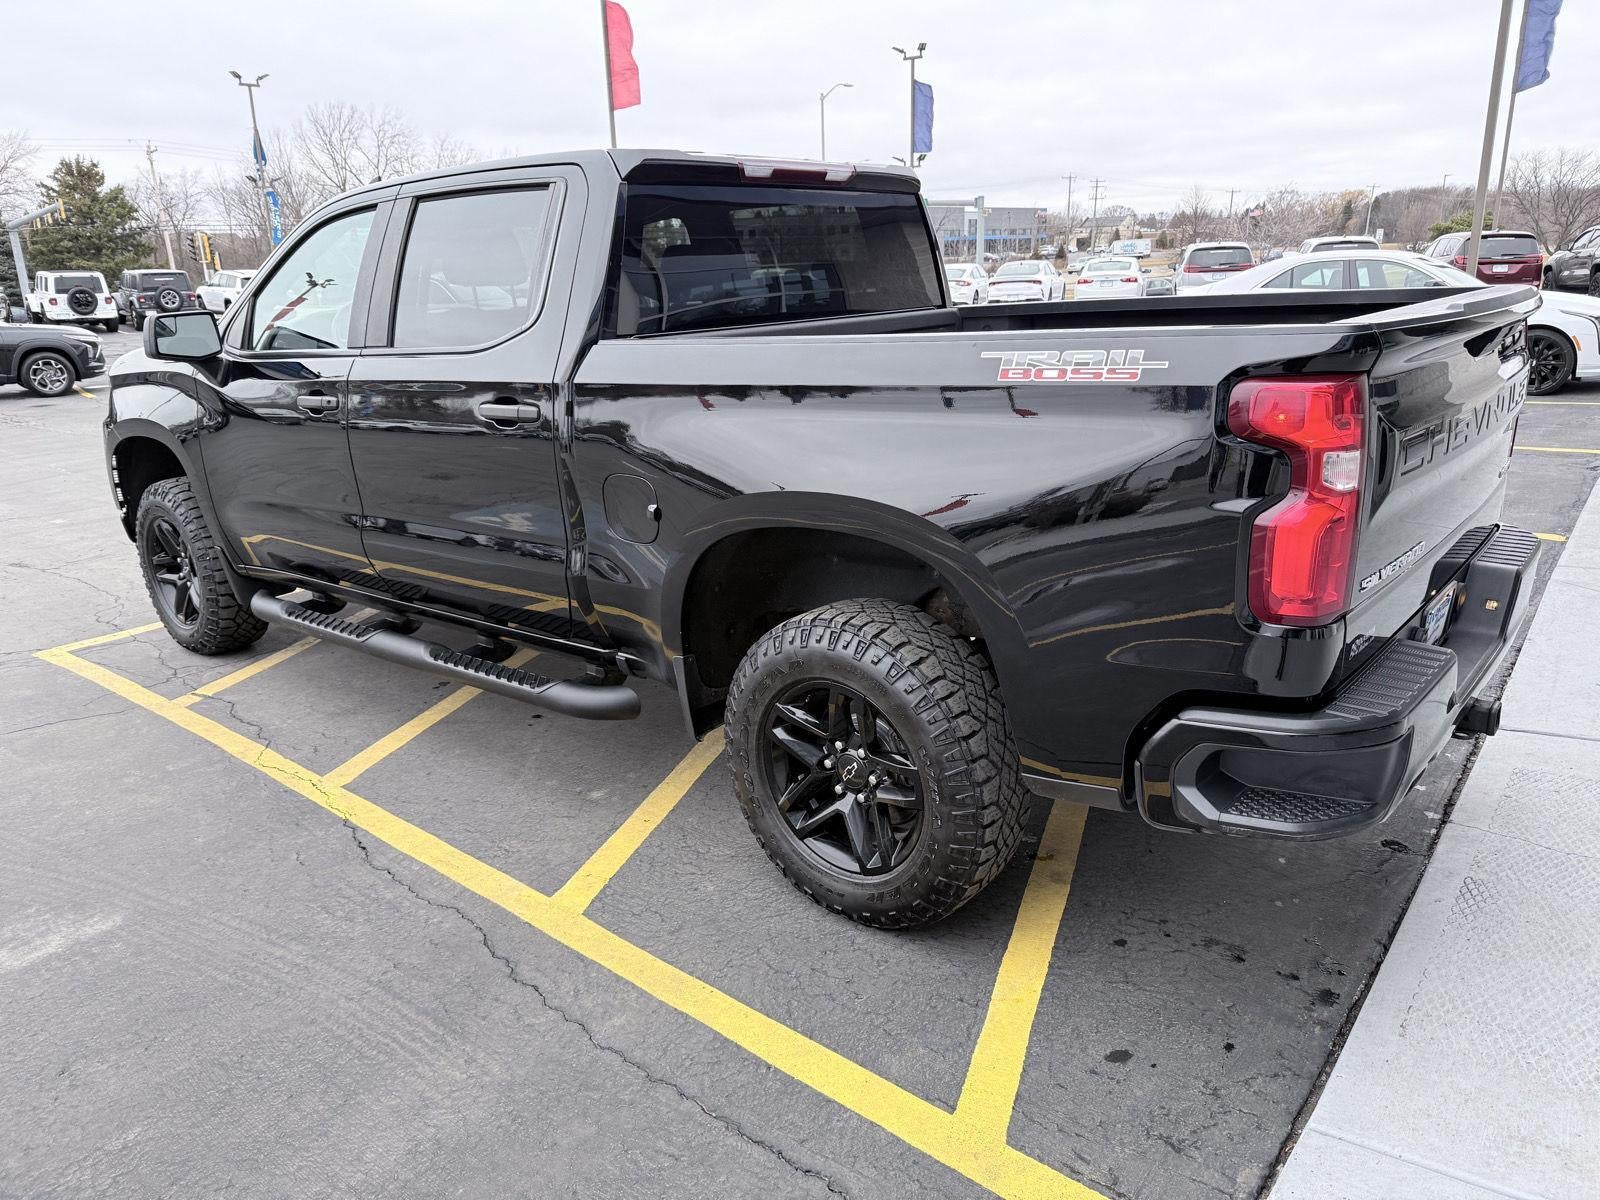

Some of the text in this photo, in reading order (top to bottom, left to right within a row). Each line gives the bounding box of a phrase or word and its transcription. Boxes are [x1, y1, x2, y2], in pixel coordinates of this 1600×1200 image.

[981, 350, 1169, 369] TRAIL
[998, 367, 1142, 382] BOSS
[1359, 541, 1426, 593] SILVERADO
